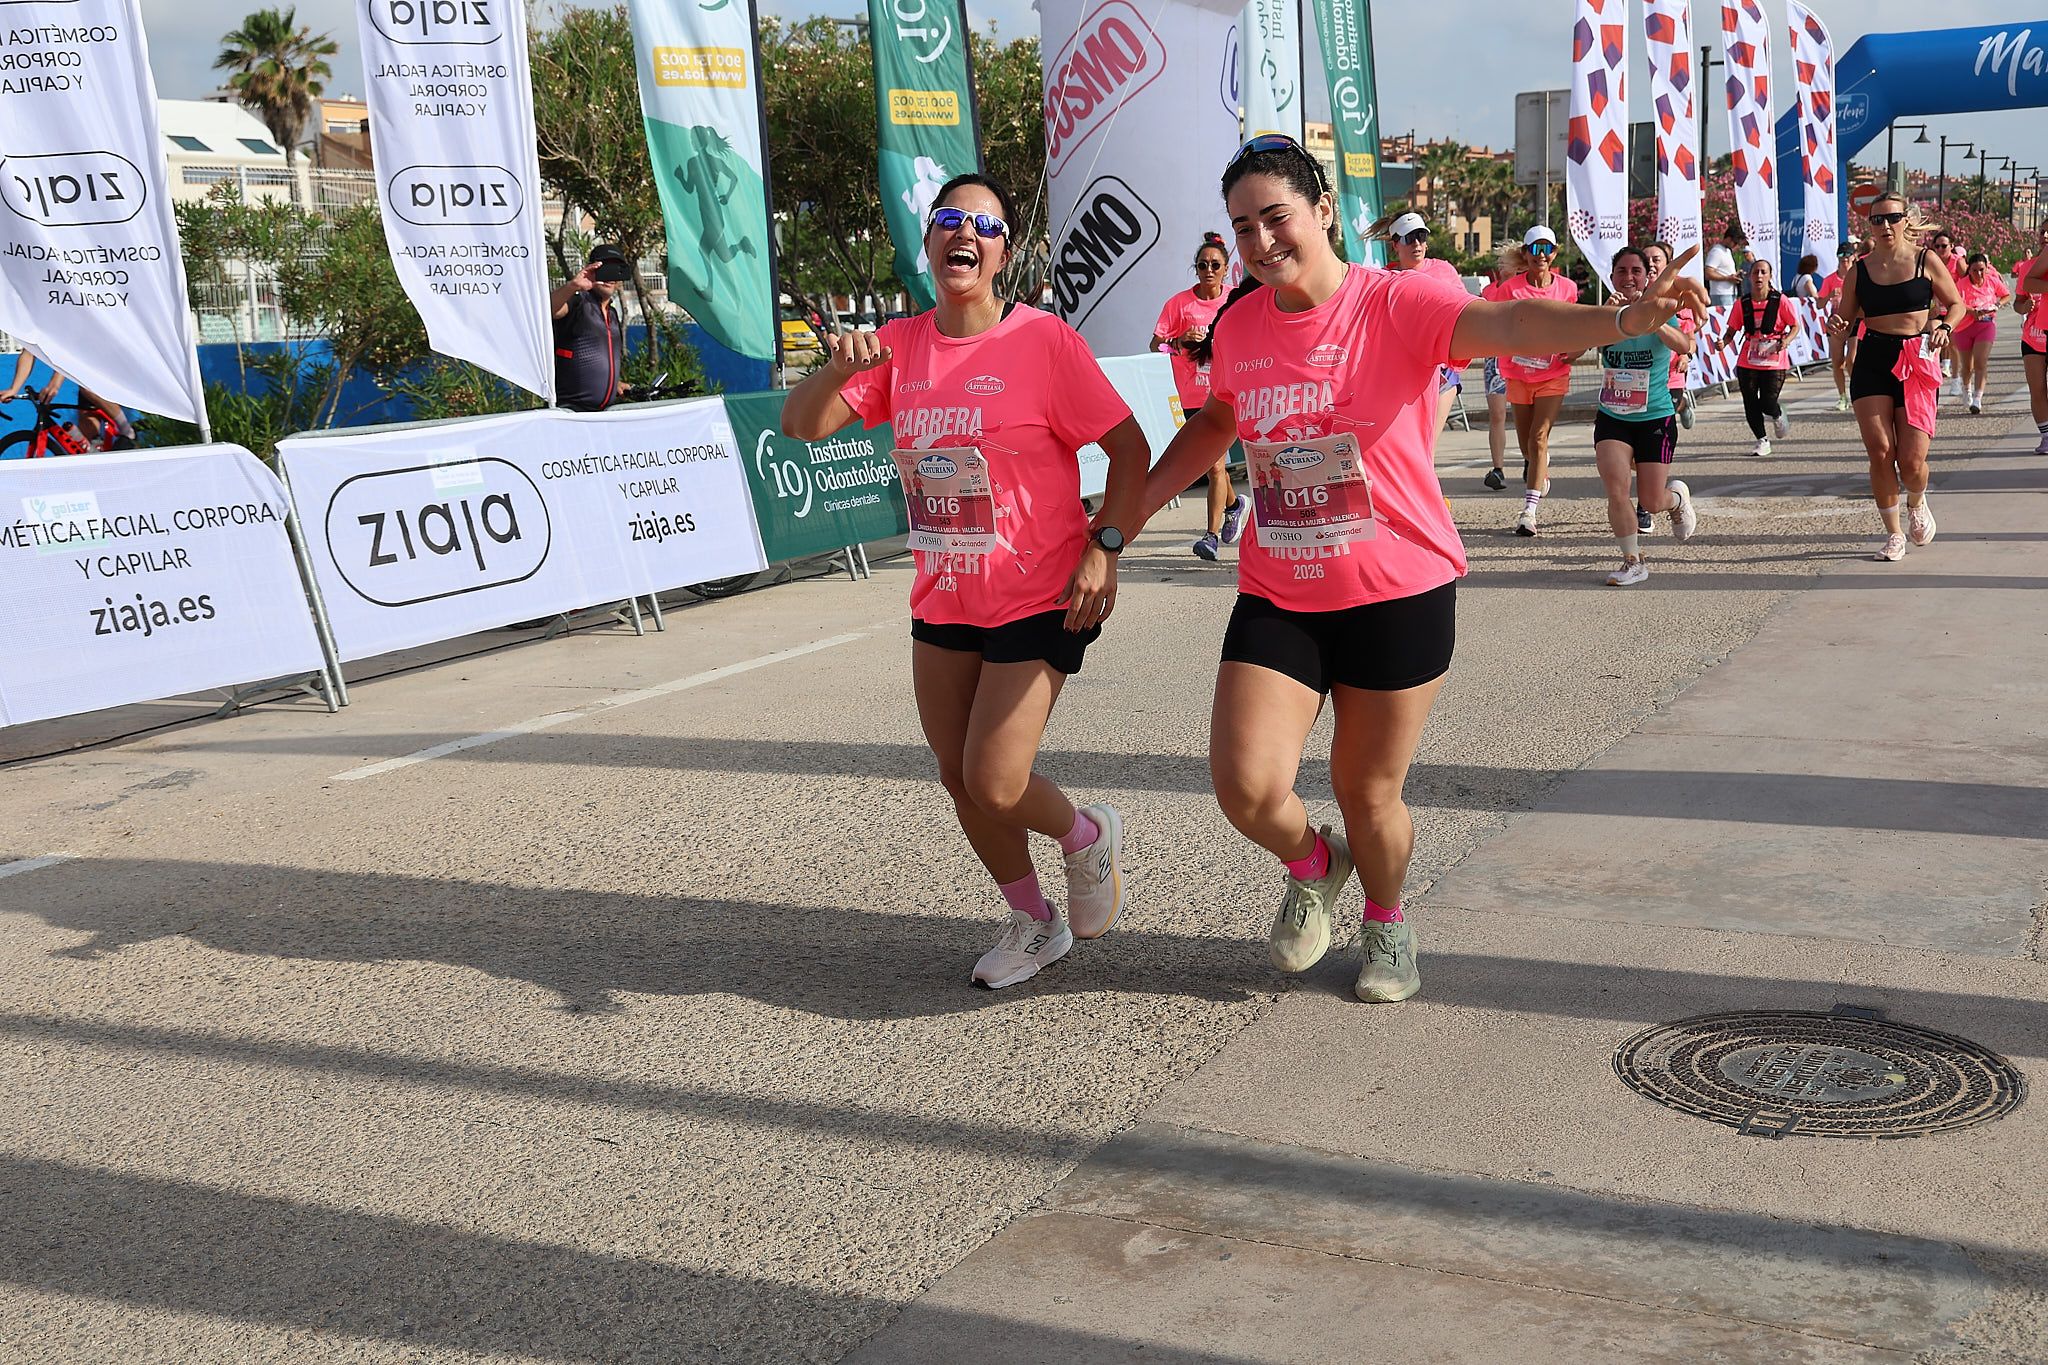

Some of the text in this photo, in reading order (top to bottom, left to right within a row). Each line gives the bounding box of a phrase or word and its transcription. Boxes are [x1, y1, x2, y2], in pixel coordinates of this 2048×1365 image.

[1974, 28, 2048, 96] Ma
[1045, 17, 1147, 159] COSMO
[1234, 357, 1273, 373] OYSHO
[1237, 379, 1336, 422] CARRERA
[1614, 390, 1631, 398] 016
[895, 406, 984, 439] CARRERA
[542, 443, 729, 479] COSMÉTICA FACIAL, CORPORAL
[805, 437, 874, 465] Institutos
[815, 458, 899, 492] Odontológic
[920, 464, 955, 474] ASTURIANA
[618, 477, 680, 499] Y CAPILAR
[850, 493, 880, 508] dentales
[1284, 485, 1329, 508] 016
[926, 496, 960, 514] 016
[1300, 509, 1316, 518] 508
[87, 513, 170, 540] FACIAL,
[173, 502, 283, 531] CORPORA
[358, 492, 522, 571] ziaja
[628, 511, 696, 543] ziaja.es
[1267, 519, 1289, 527] CARRERA
[1305, 518, 1326, 526] MUJER
[1330, 513, 1360, 524] VALENCIA
[1270, 527, 1362, 541] OYSHO Santander
[75, 548, 192, 580] Y CAPILAR
[1293, 563, 1325, 580] 2026
[90, 593, 215, 637] ziaja.es
